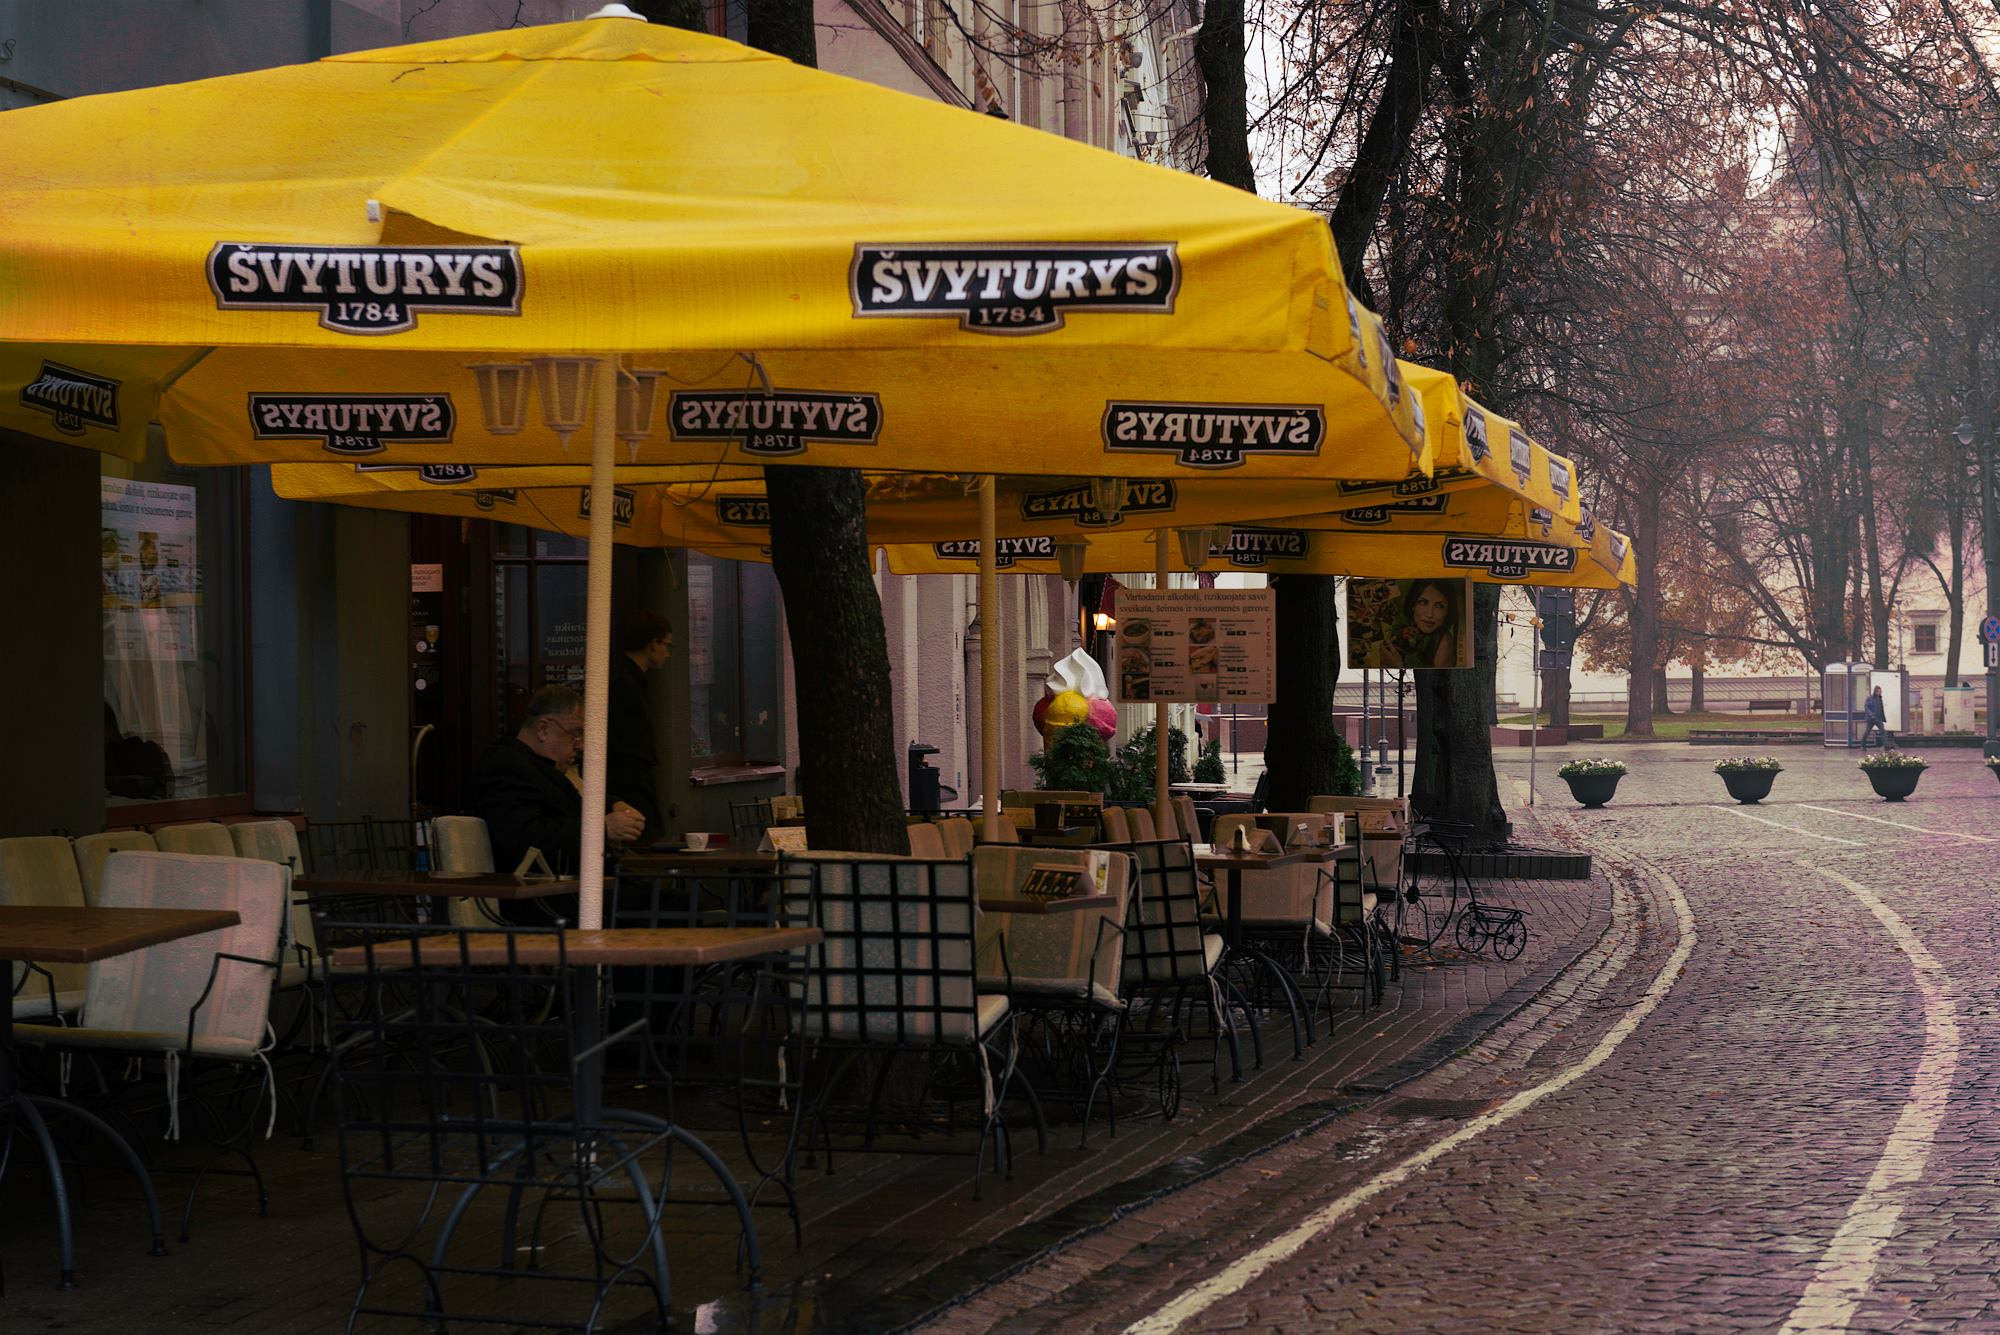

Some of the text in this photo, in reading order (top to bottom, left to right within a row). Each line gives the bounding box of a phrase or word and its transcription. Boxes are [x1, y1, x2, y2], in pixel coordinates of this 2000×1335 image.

[228, 246, 504, 299] ŠVYTURYS
[872, 252, 1159, 304] ŠVYTURYS
[337, 302, 400, 322] 1784
[979, 307, 1046, 326] 1784
[429, 465, 465, 476] 1784
[1350, 509, 1382, 519] 1784
